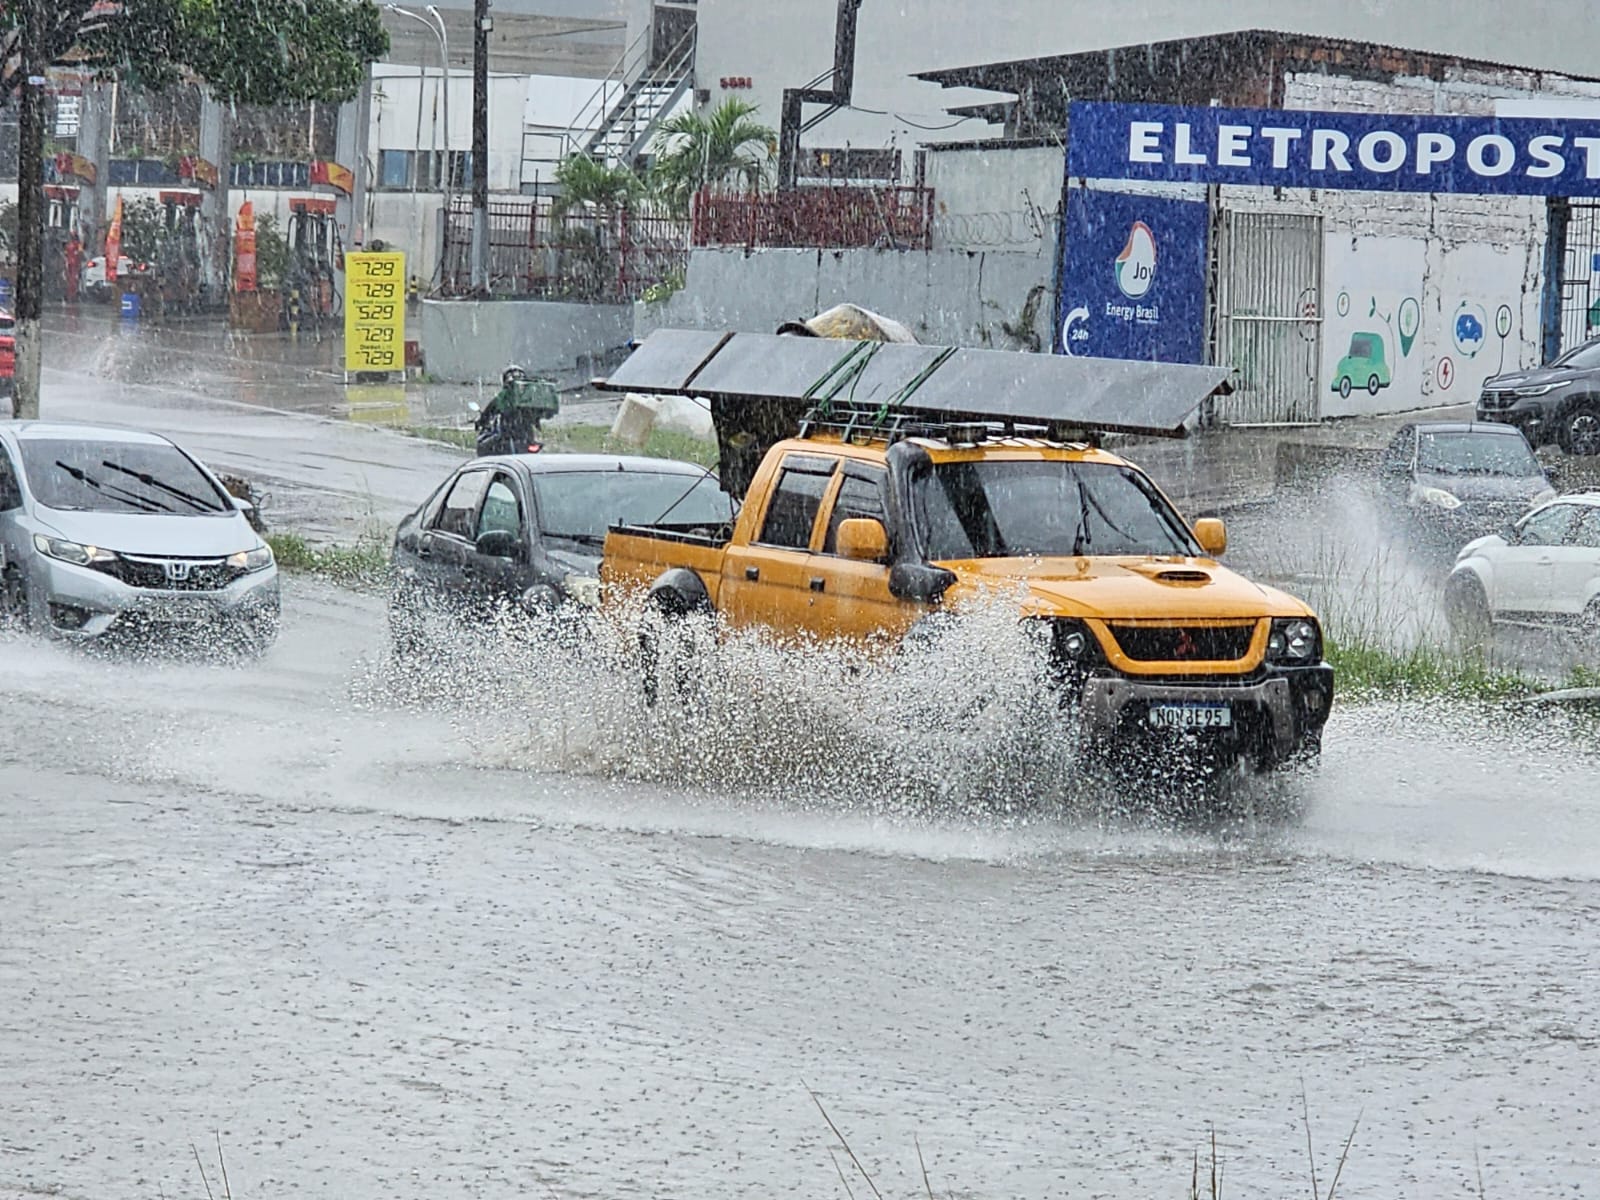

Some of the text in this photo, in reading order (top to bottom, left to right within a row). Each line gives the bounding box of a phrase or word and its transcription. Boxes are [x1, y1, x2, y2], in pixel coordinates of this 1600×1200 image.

[1128, 121, 1600, 179] ELETROPOST
[1133, 262, 1156, 285] Joy
[1106, 302, 1159, 320] Energy Brasil
[1072, 328, 1089, 340] 24h
